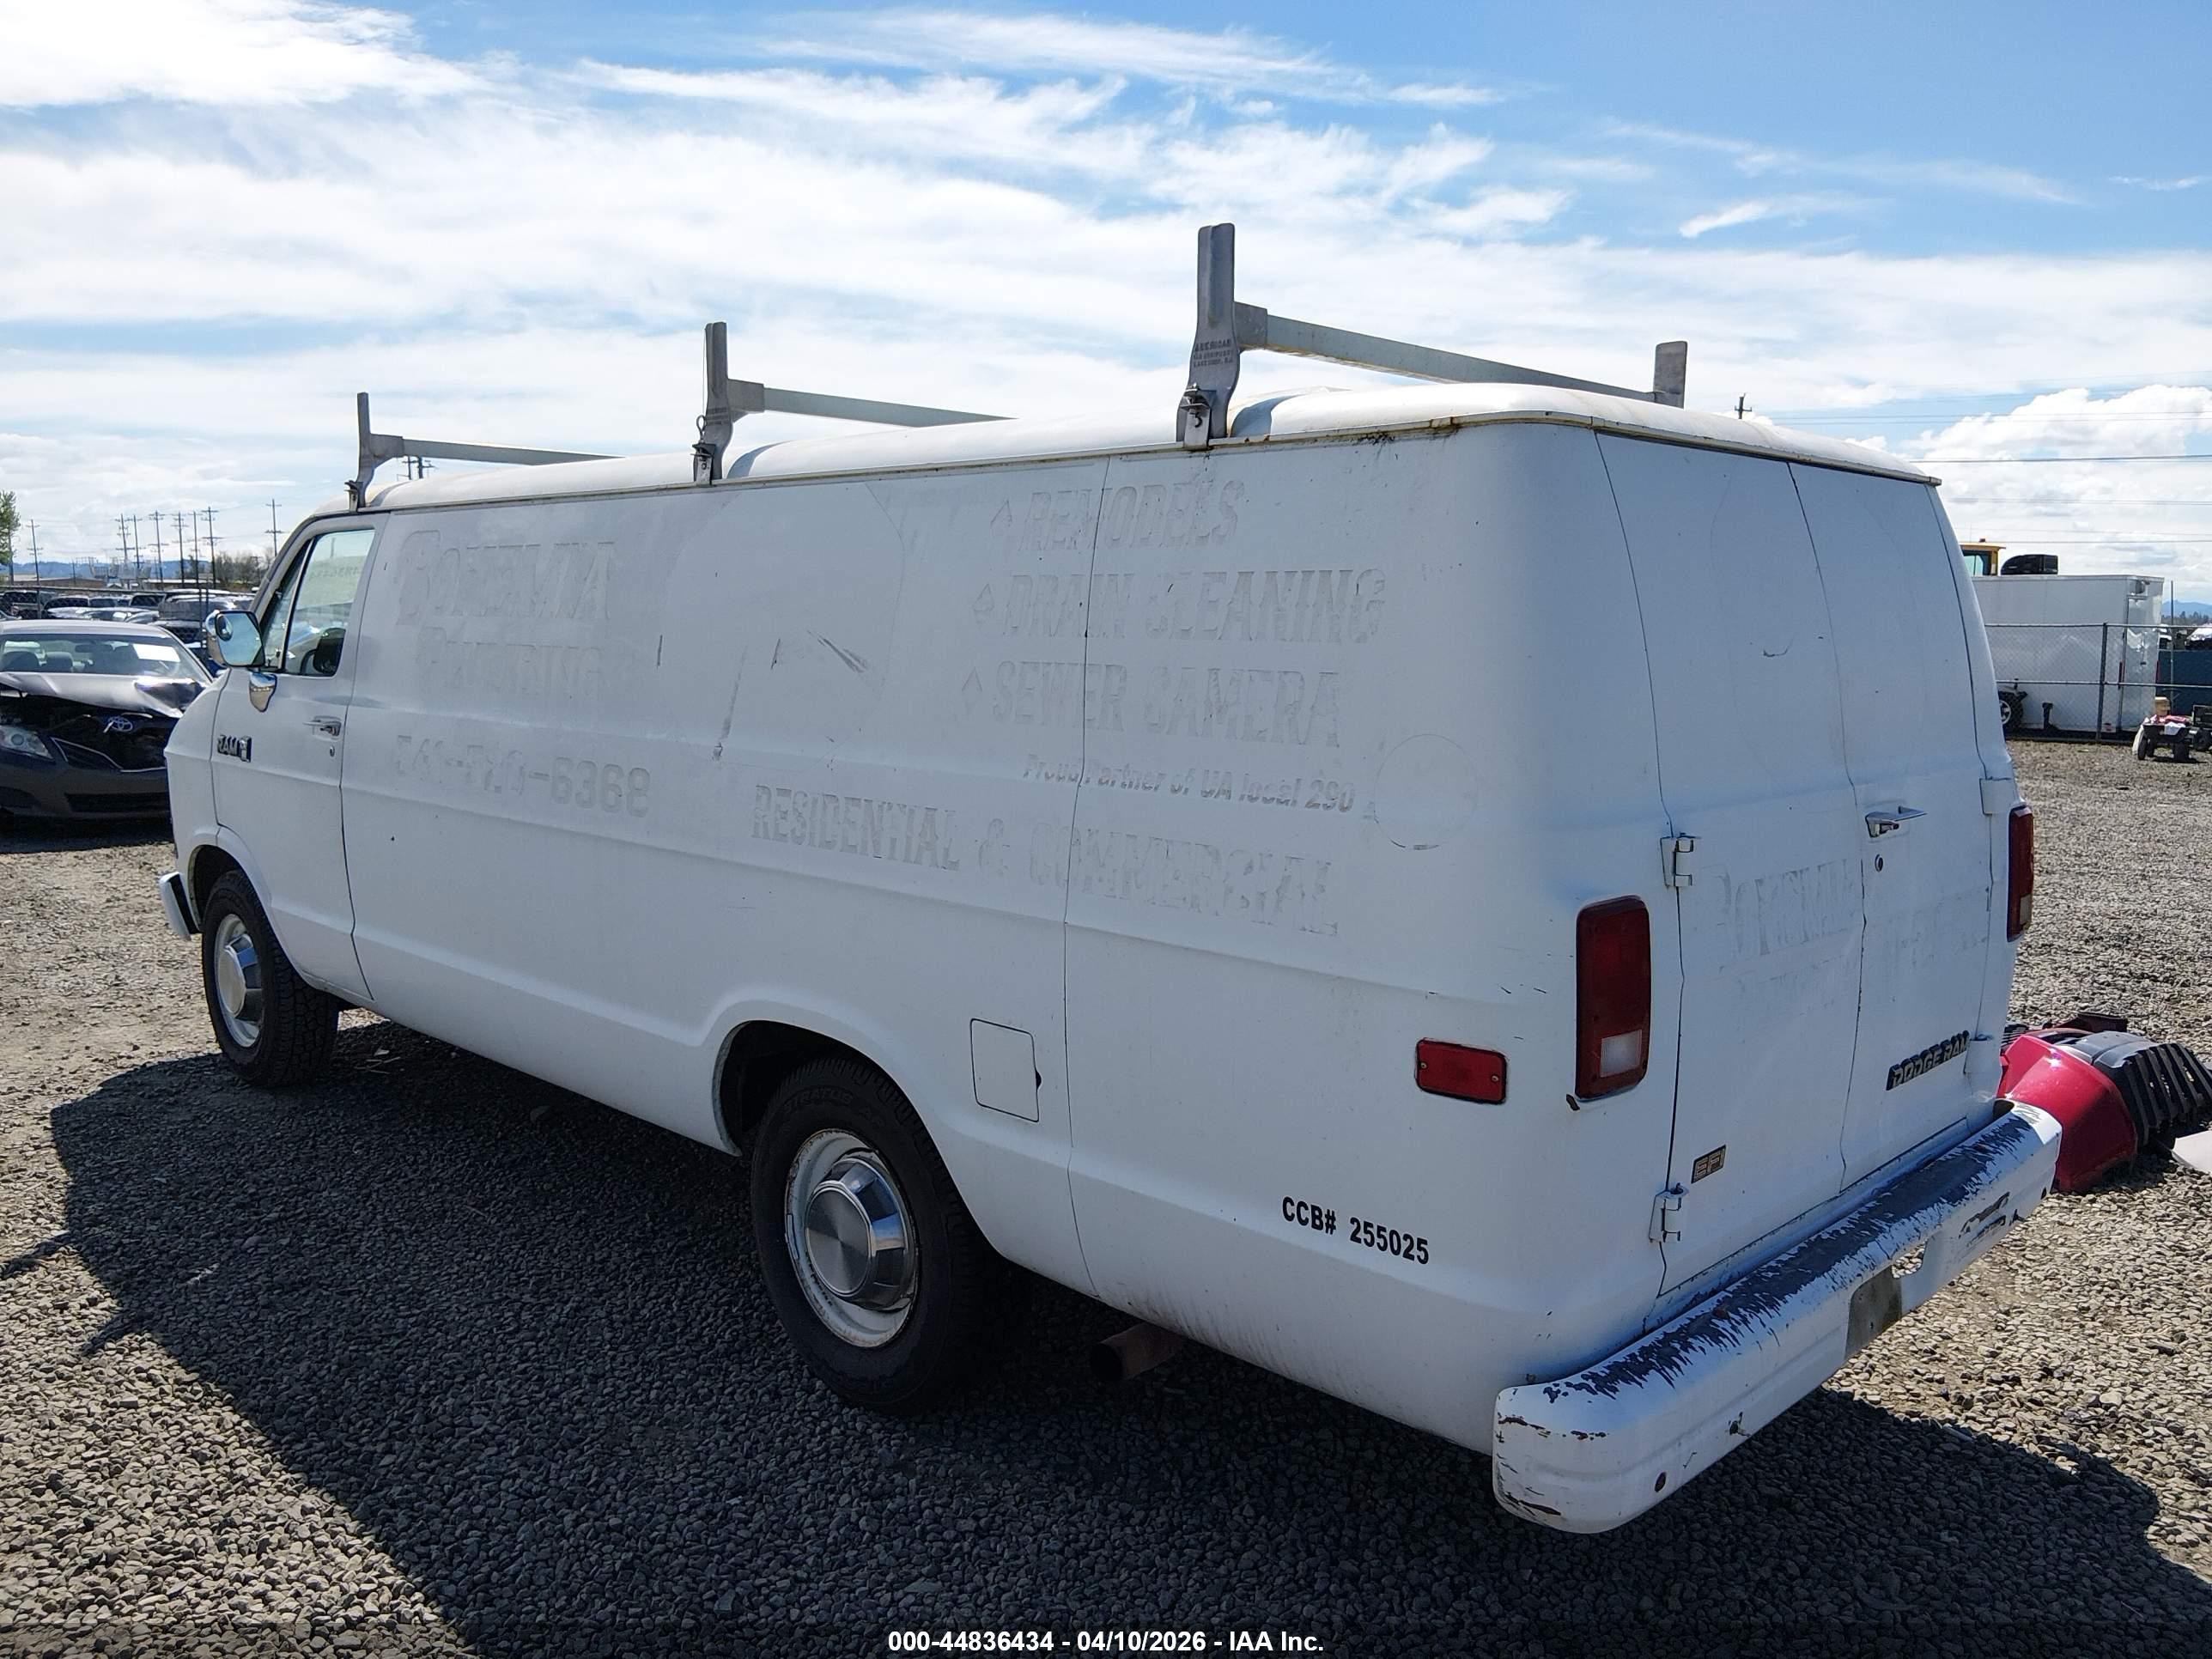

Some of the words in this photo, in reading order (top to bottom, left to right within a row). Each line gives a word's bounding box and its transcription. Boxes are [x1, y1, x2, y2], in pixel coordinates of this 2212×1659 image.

[1019, 479, 1246, 551] REMODELS
[1003, 573, 1135, 639] DRAIN
[1145, 568, 1386, 644] CLEANING
[992, 659, 1127, 732] SEWER
[1142, 665, 1340, 748] CAMERA
[1085, 757, 1167, 793] Partner
[1170, 767, 1197, 796] of
[1200, 769, 1232, 800] UA
[1304, 778, 1356, 813] 290
[751, 783, 961, 871] RESIDENTIAL
[1030, 822, 1340, 938] COMMERCIAL
[1887, 1043, 1942, 1089] DODGE
[1941, 1030, 1970, 1061] RAM
[1693, 1147, 1725, 1182] EFI
[1282, 1196, 1337, 1235] CCB#
[1349, 1216, 1430, 1265] 255025
